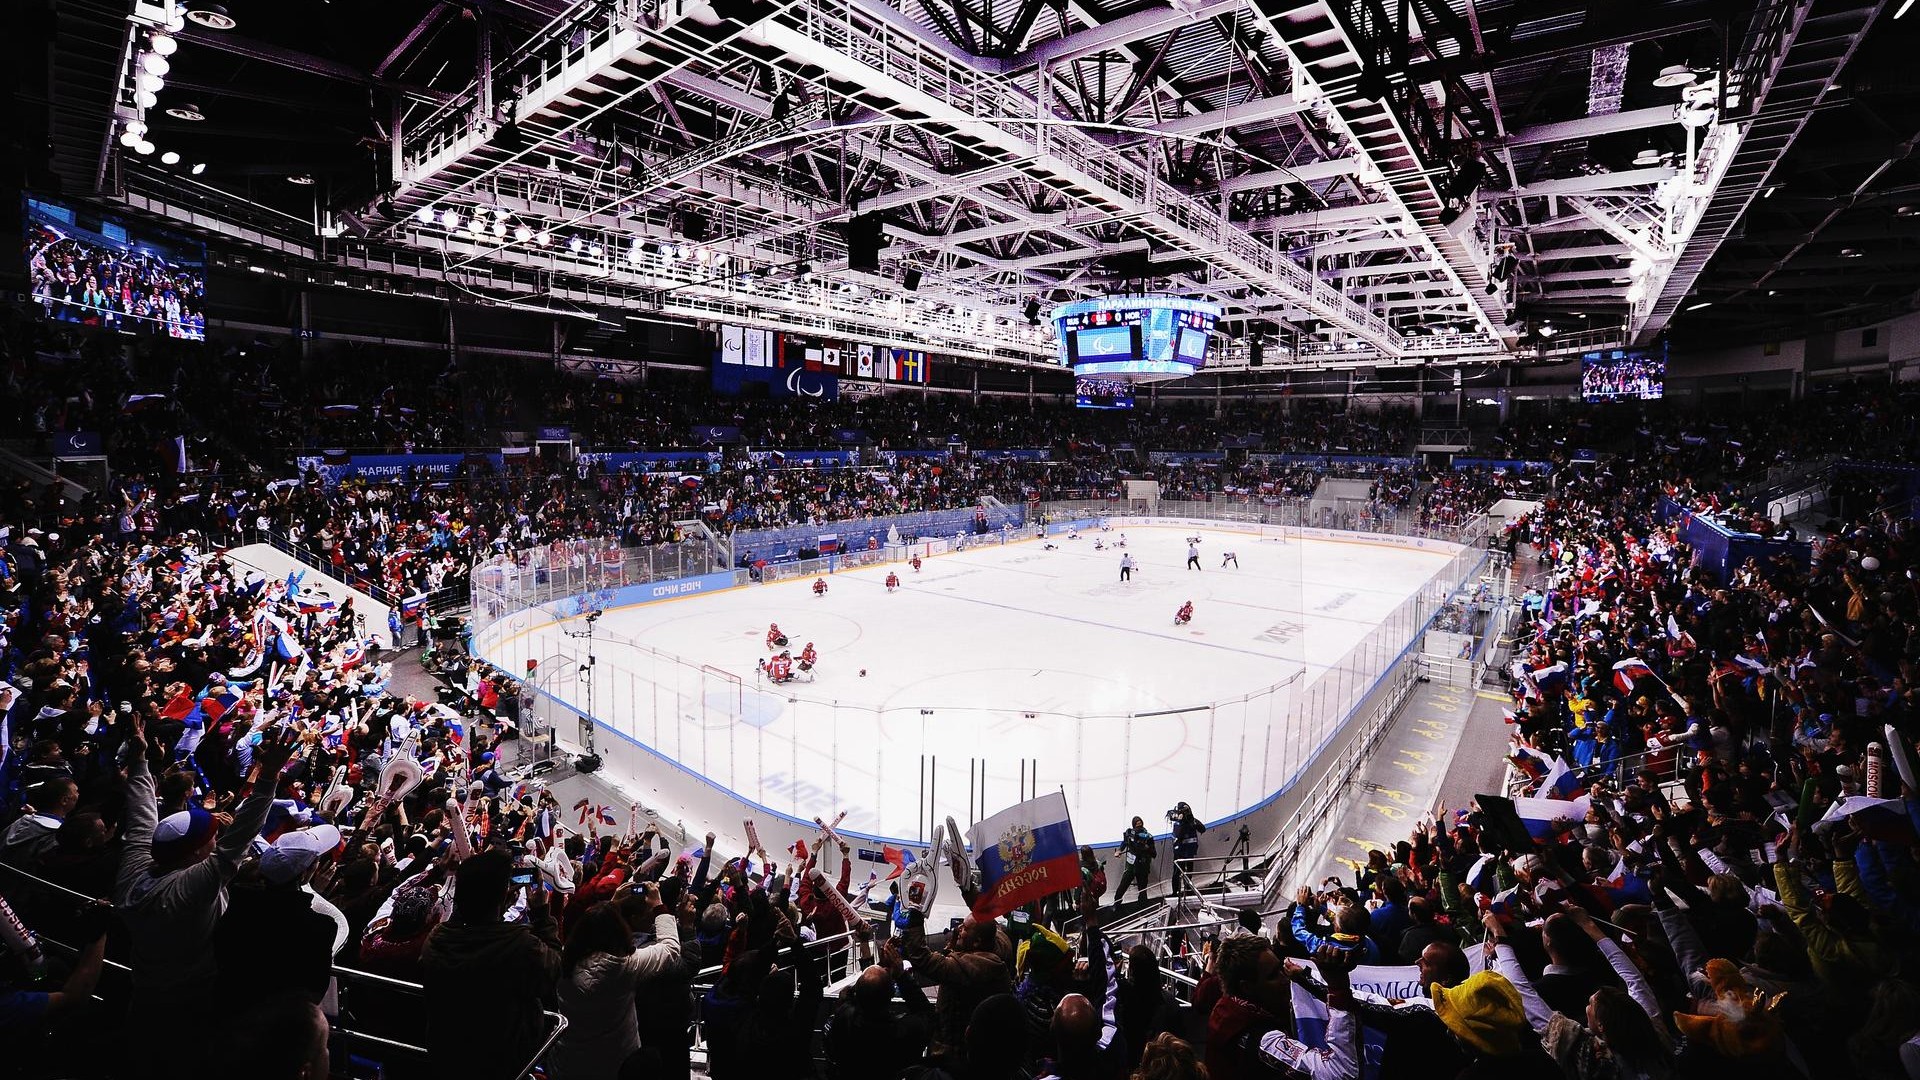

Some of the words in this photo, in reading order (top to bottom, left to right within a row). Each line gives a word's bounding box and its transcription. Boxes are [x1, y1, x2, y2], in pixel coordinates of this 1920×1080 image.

[1082, 315, 1089, 325] 4
[653, 584, 679, 597] СОЧИ
[680, 580, 702, 592] 2014
[779, 664, 785, 675] 5
[823, 887, 858, 922] MOSCOW
